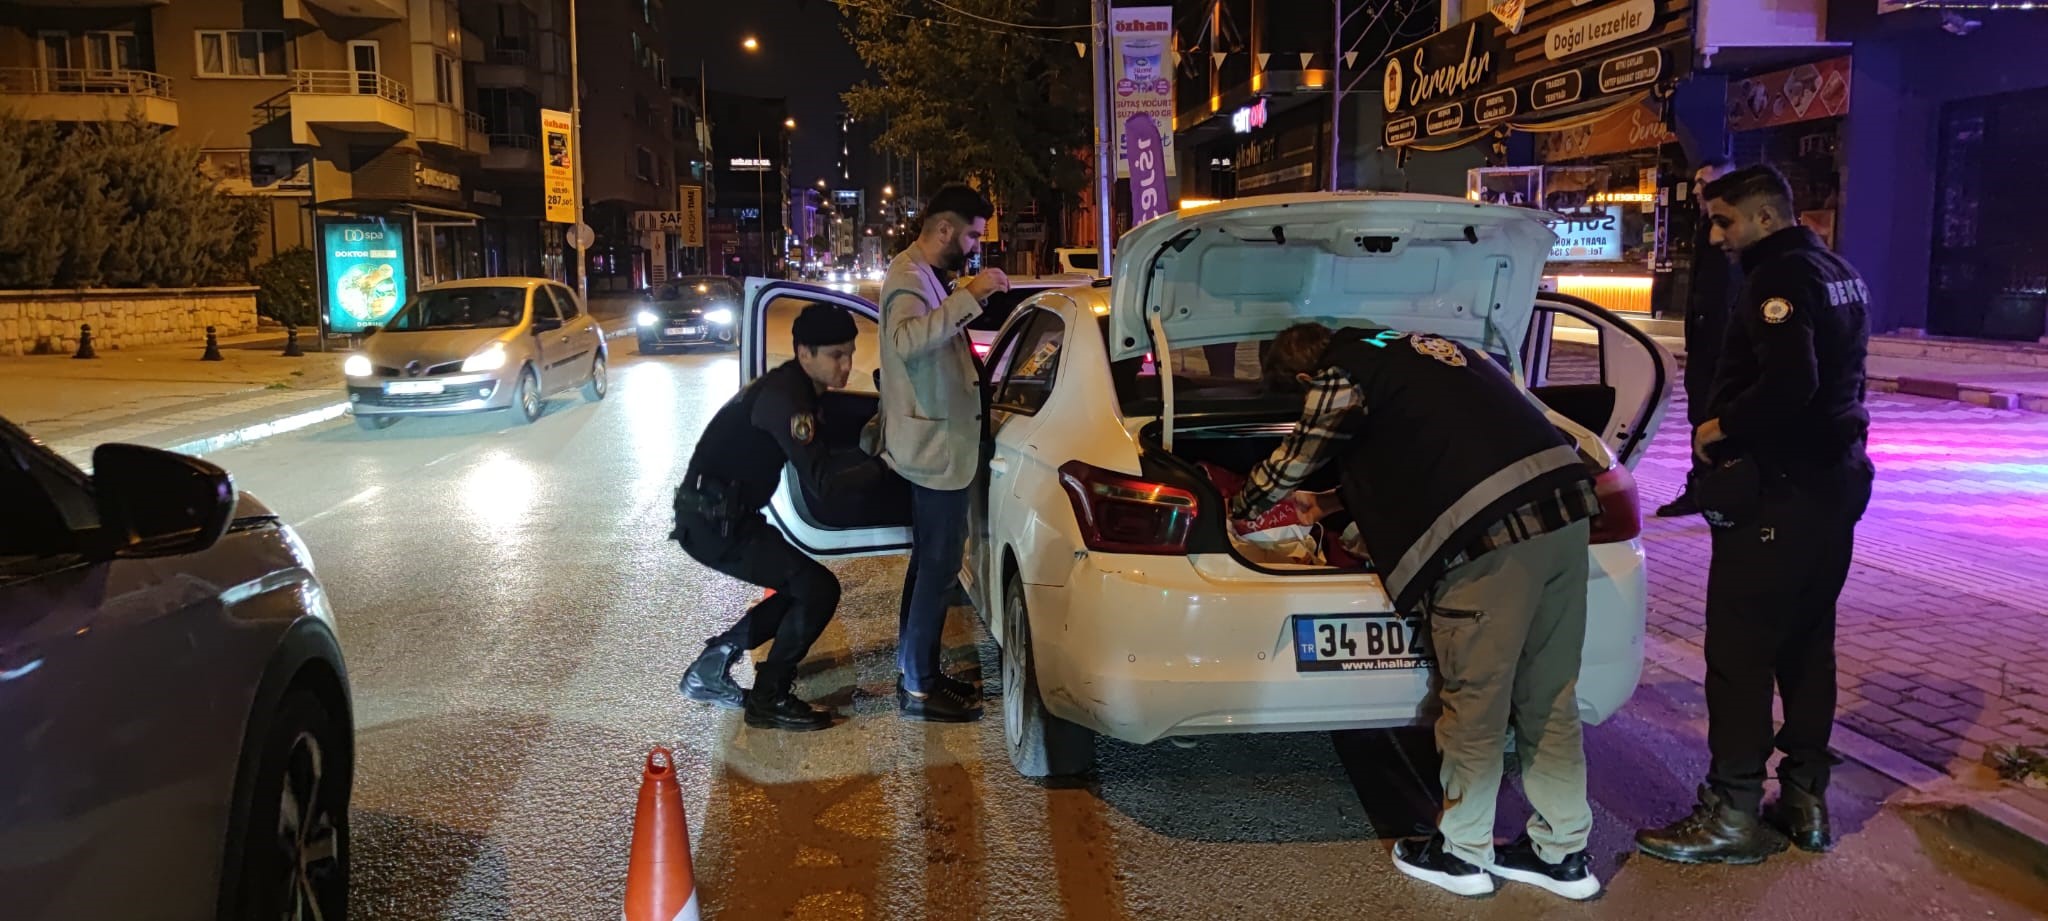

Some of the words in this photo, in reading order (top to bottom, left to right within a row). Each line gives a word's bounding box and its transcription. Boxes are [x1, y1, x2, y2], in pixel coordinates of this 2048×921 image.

[1115, 19, 1168, 32] özhan
[1554, 25, 1584, 52] Doğal
[1588, 10, 1643, 41] Lezzetler
[335, 250, 368, 258] DOKTOR
[1318, 623, 1357, 657] 34
[1365, 620, 1424, 656] BDZ
[1301, 644, 1315, 653] TR
